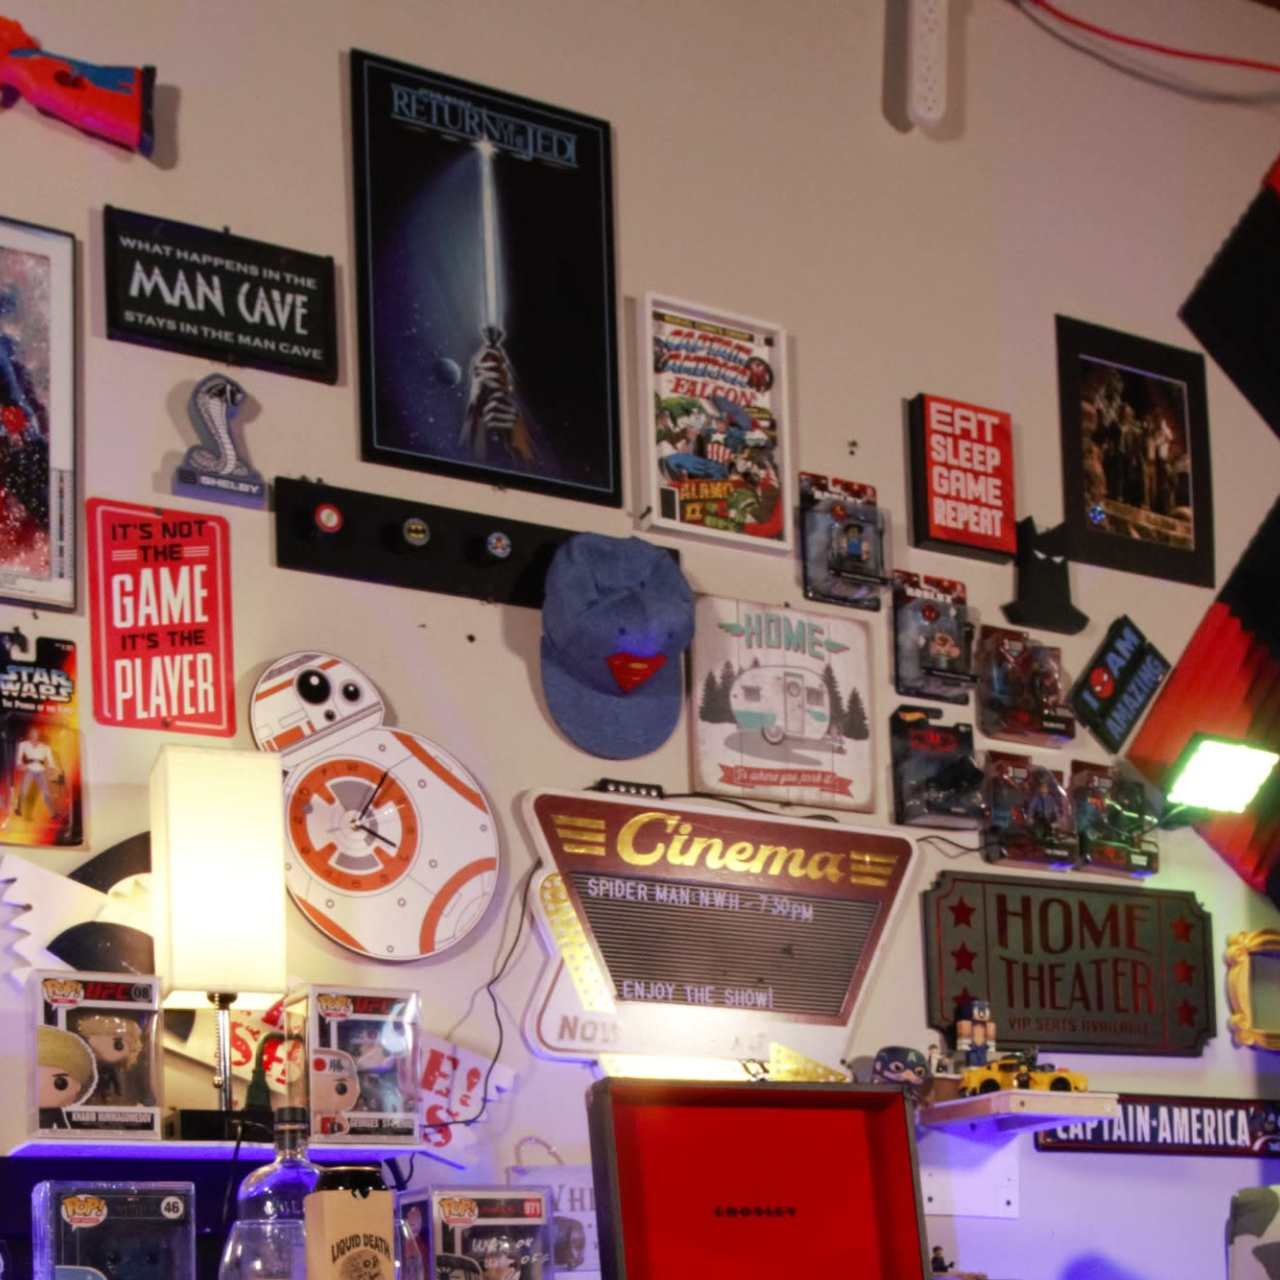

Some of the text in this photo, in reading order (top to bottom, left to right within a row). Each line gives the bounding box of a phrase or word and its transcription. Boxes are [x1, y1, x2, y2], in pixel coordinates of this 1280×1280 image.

[390, 82, 502, 140] RETURN
[523, 124, 579, 168] JEDI
[119, 235, 318, 290] WHAT HAPPENS IN THE
[129, 259, 310, 336] MAN CAVE
[123, 309, 324, 361] STAYS IN THE MAN CAVE
[671, 376, 757, 407] FALCON
[929, 401, 1000, 443] EAT
[930, 433, 1001, 475] SLEEP
[200, 475, 259, 494] SHELBY
[931, 463, 1003, 507] GAME
[111, 519, 207, 541] IT'S NOT
[933, 497, 1005, 538] REPEAT
[139, 544, 183, 562] THE
[112, 564, 209, 629] GAME
[121, 629, 205, 650] IT'S THE
[744, 612, 825, 661] HOME
[0, 681, 73, 702] WARS
[114, 652, 216, 721] PLAYER
[1105, 653, 1164, 740] AMAZING
[616, 811, 847, 883] Cinema
[587, 878, 648, 901] SPIDER
[655, 885, 690, 905] MAN
[994, 893, 1150, 955] HOME
[622, 980, 676, 1000] ENJOY
[684, 985, 716, 1004] THE
[998, 955, 1156, 1016] THEATER
[163, 1200, 181, 1215] 46
[331, 1233, 391, 1265] LIQUID DEATH
